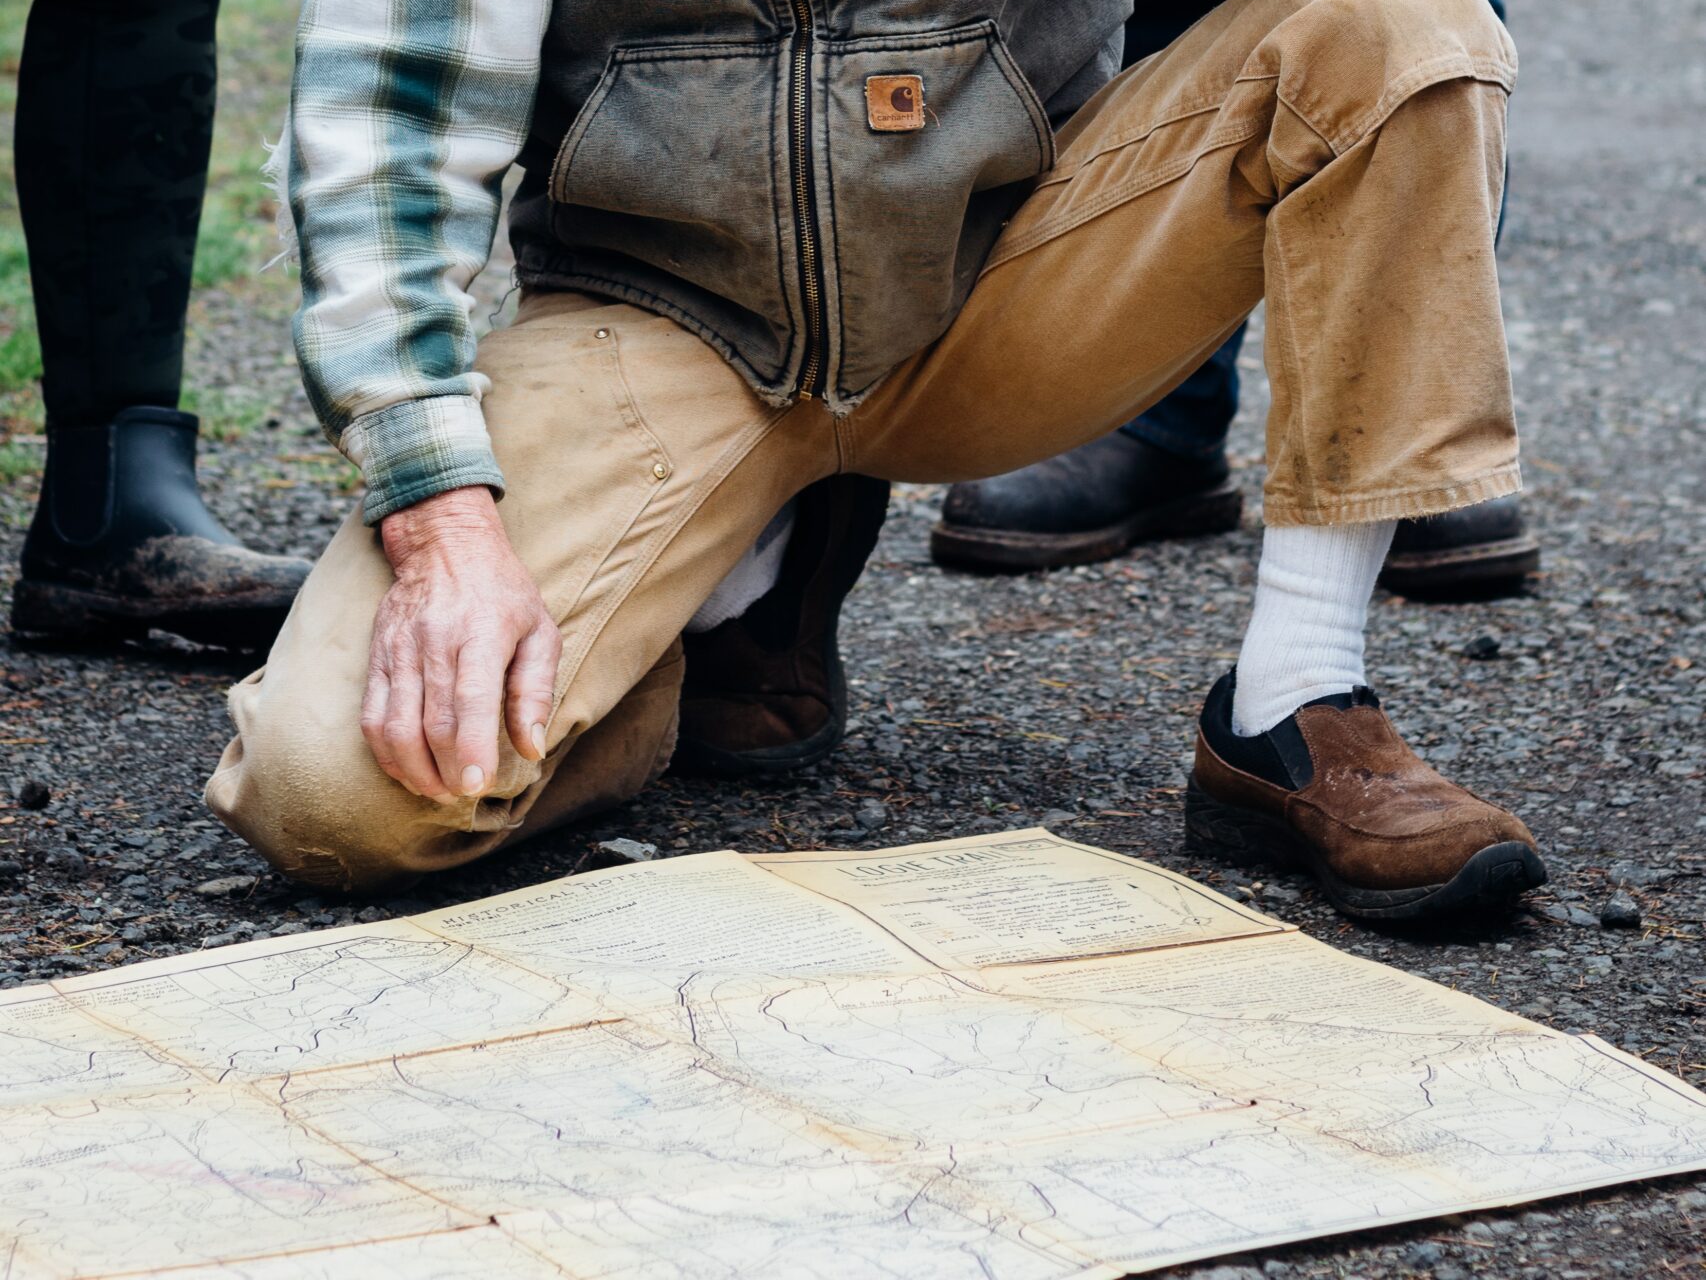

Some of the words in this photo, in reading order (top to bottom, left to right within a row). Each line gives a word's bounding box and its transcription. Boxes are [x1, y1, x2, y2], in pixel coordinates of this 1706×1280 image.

[877, 113, 914, 122] carhartt
[835, 860, 936, 879] LOGIE
[930, 849, 1021, 866] TRAIL
[442, 890, 576, 926] HISTORICAL
[583, 871, 657, 890] NOTES
